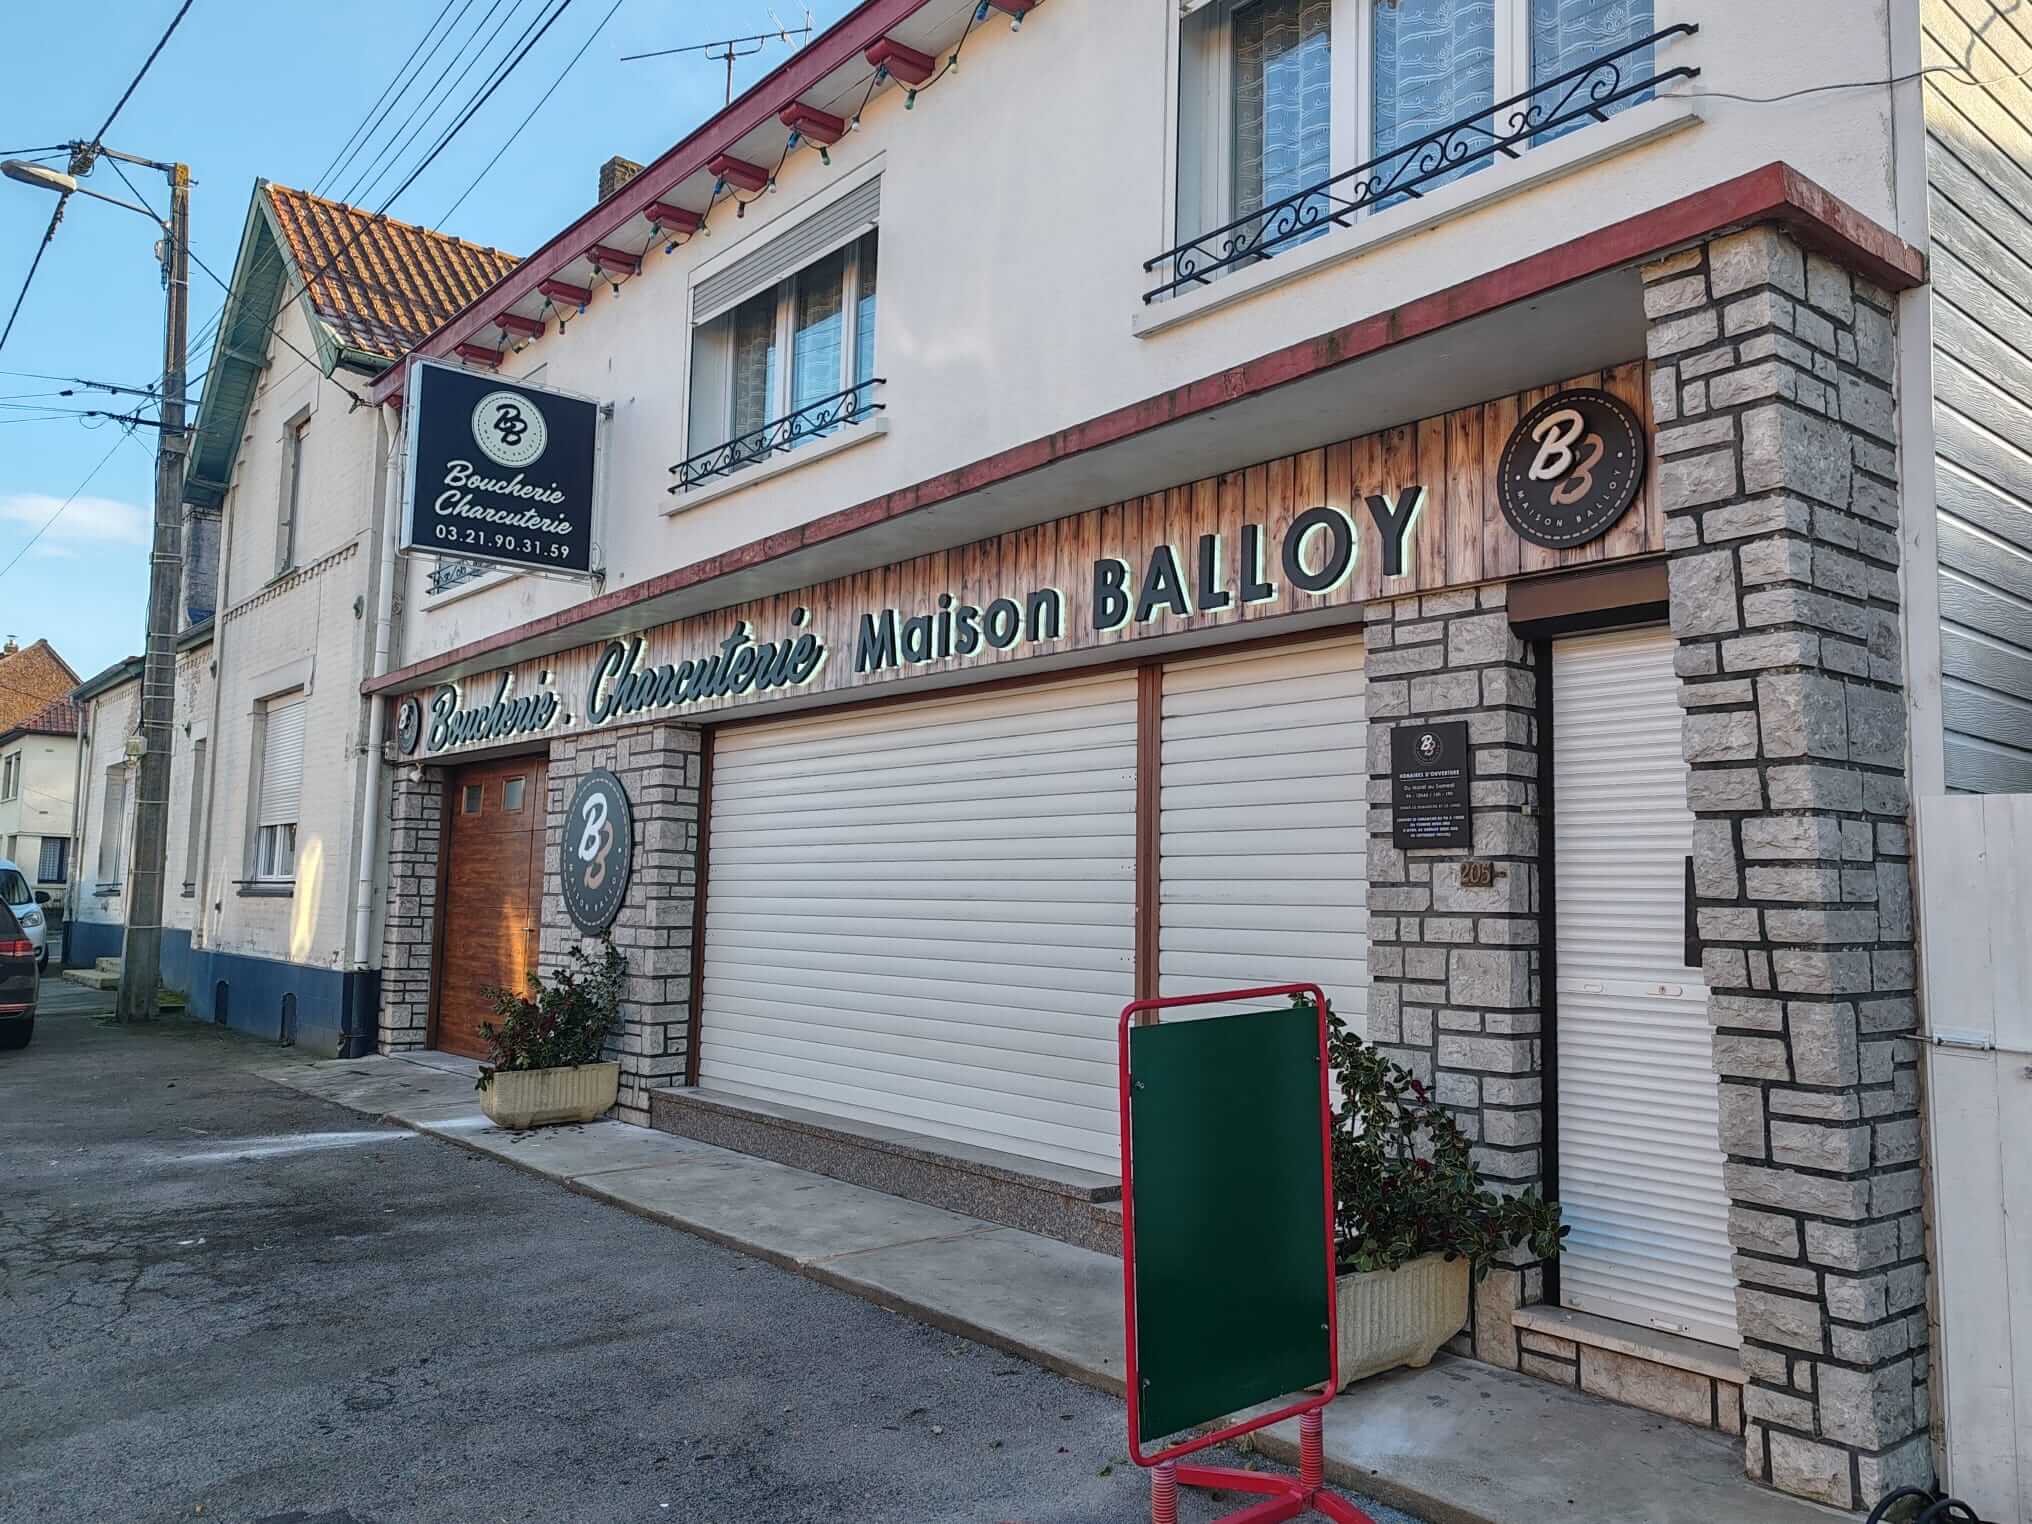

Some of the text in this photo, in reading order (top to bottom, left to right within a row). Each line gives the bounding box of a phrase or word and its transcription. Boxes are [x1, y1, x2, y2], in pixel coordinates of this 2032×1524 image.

[443, 459, 566, 504] Boucherie
[1516, 468, 1622, 527] MAISON BALLOY
[434, 490, 573, 535] Charcuterie
[435, 524, 570, 560] 03.21.90.31.59
[586, 607, 827, 725] Charcuterie
[854, 588, 1065, 674] Maison
[1092, 485, 1428, 631] BALLOY
[1460, 862, 1490, 885] 205
